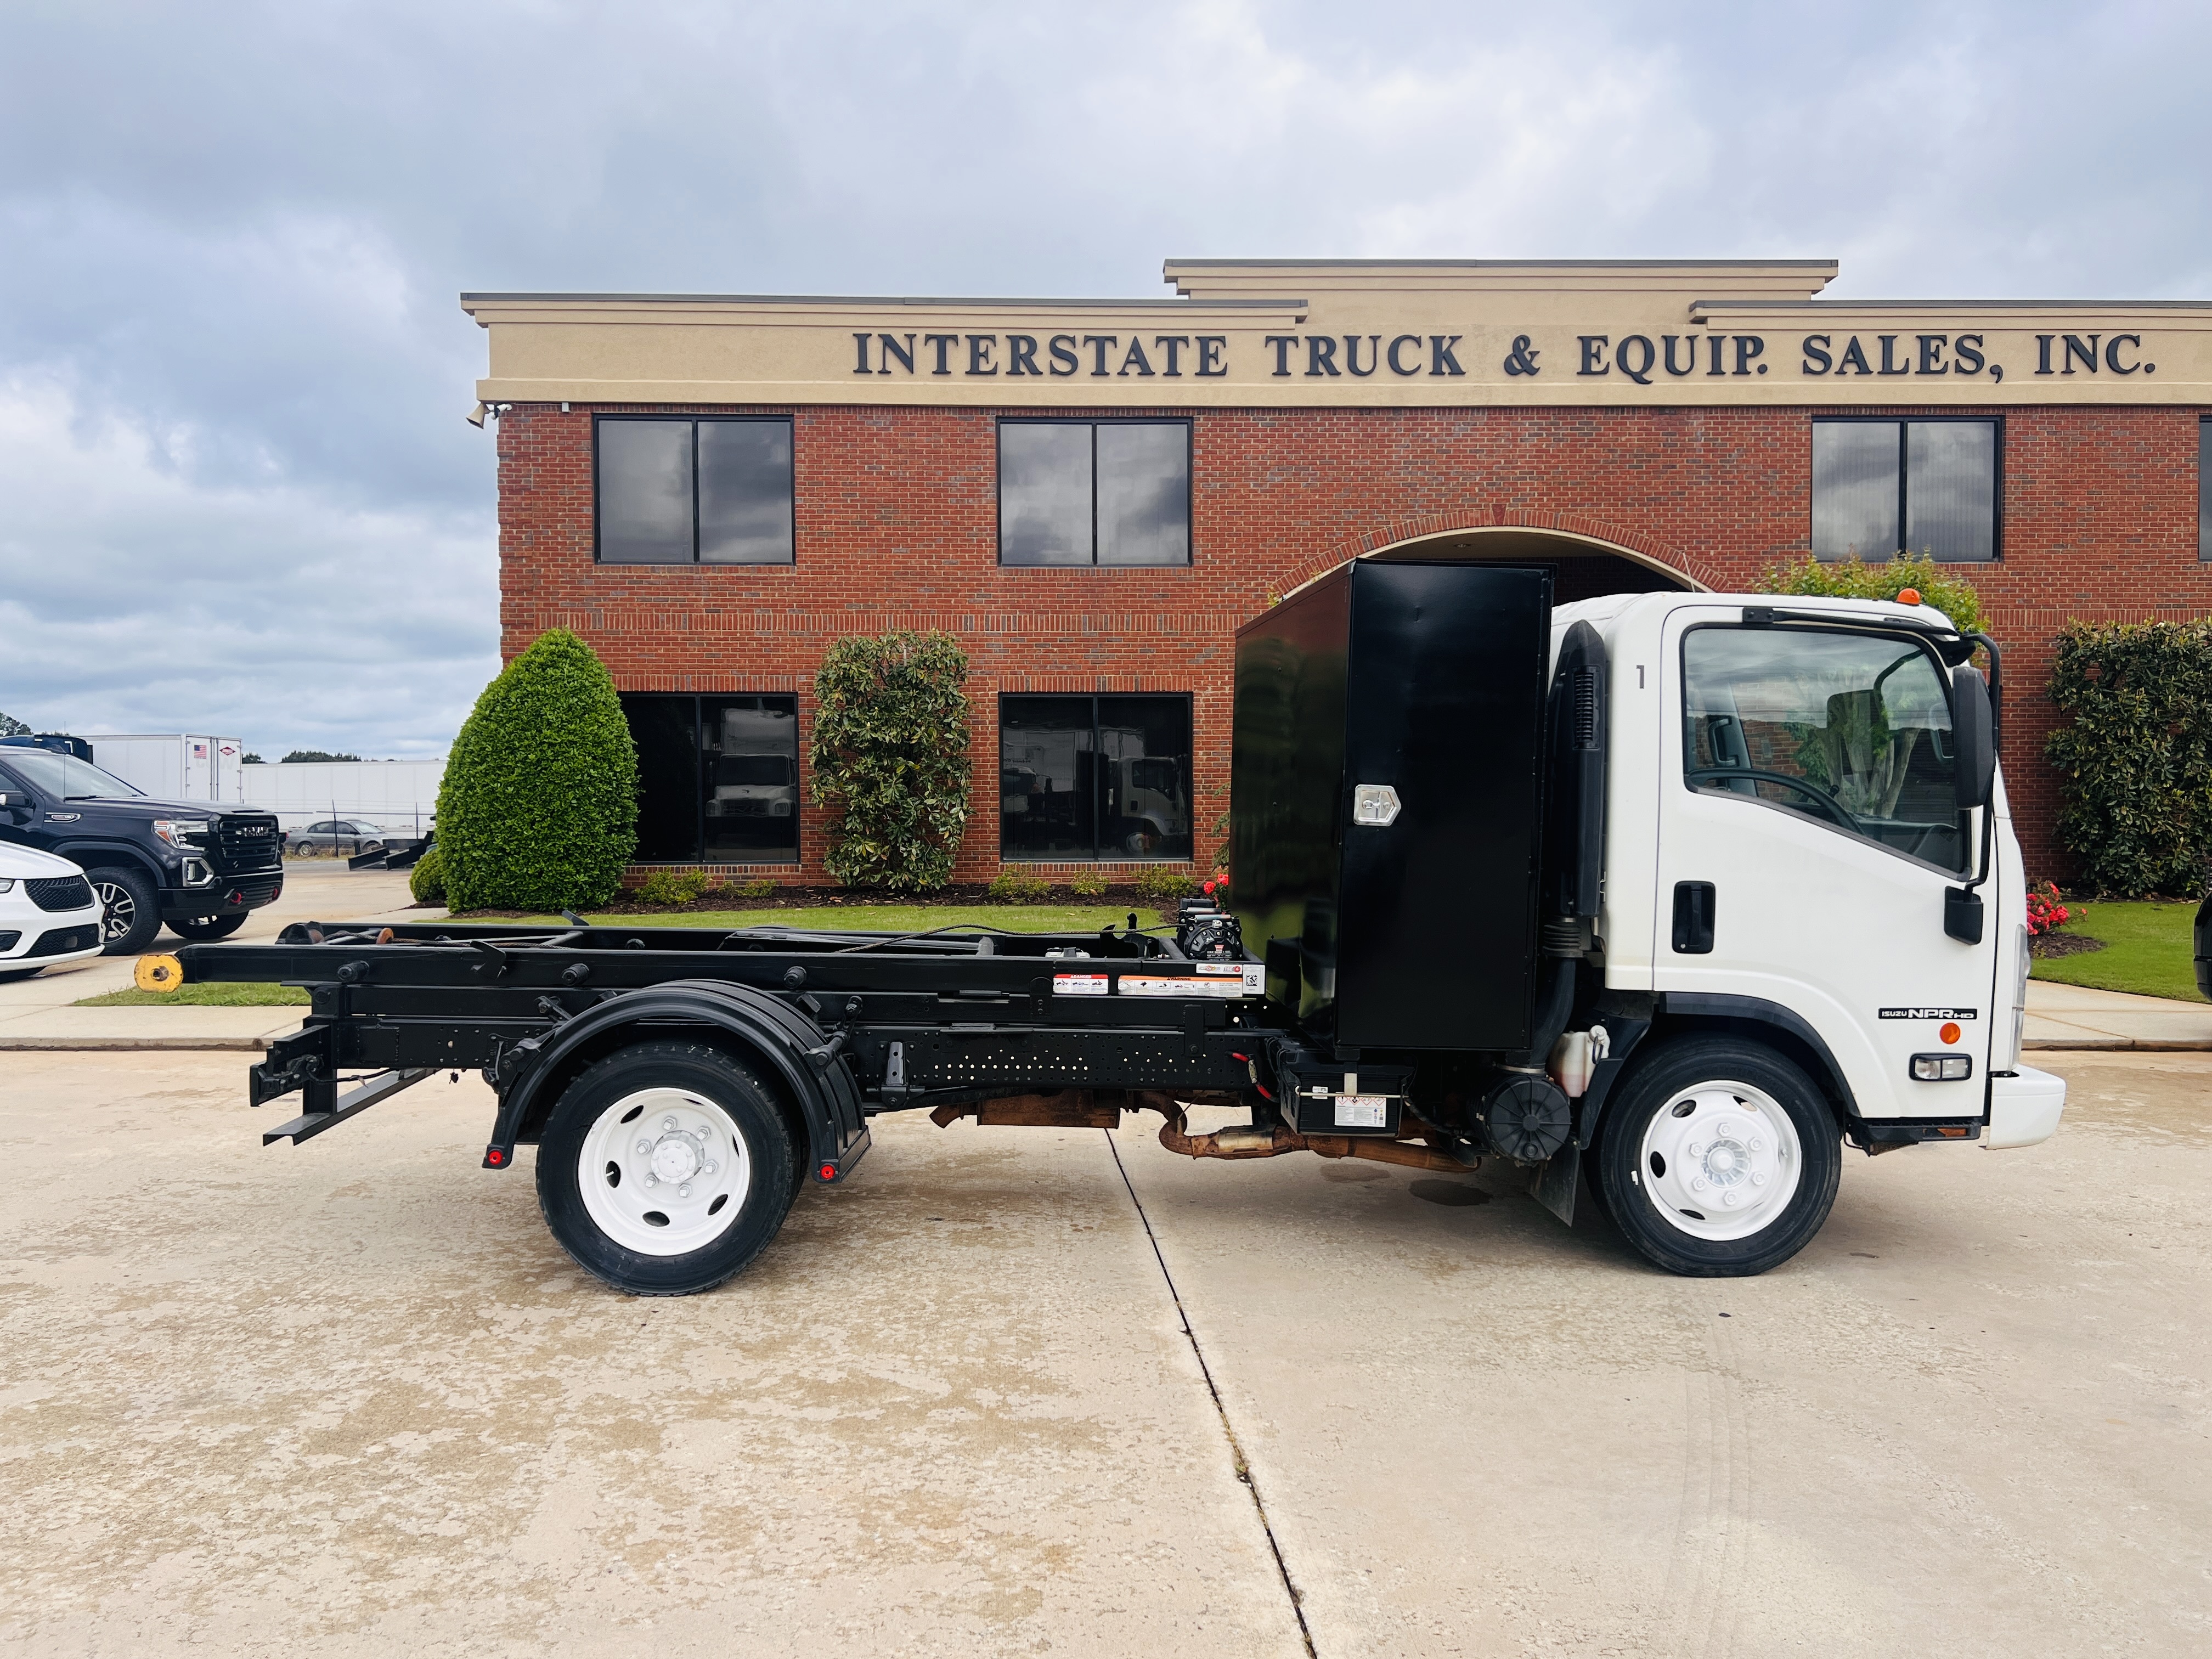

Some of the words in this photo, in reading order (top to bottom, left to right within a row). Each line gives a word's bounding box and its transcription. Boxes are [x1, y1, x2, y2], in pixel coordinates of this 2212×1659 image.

[853, 333, 1228, 377] INTERSTATE
[1265, 335, 1466, 377] TRUCK
[1503, 335, 1541, 376] &
[1576, 334, 1768, 385] EQUIP.
[1802, 334, 2004, 384] SALES,
[2034, 334, 2155, 375] INC.
